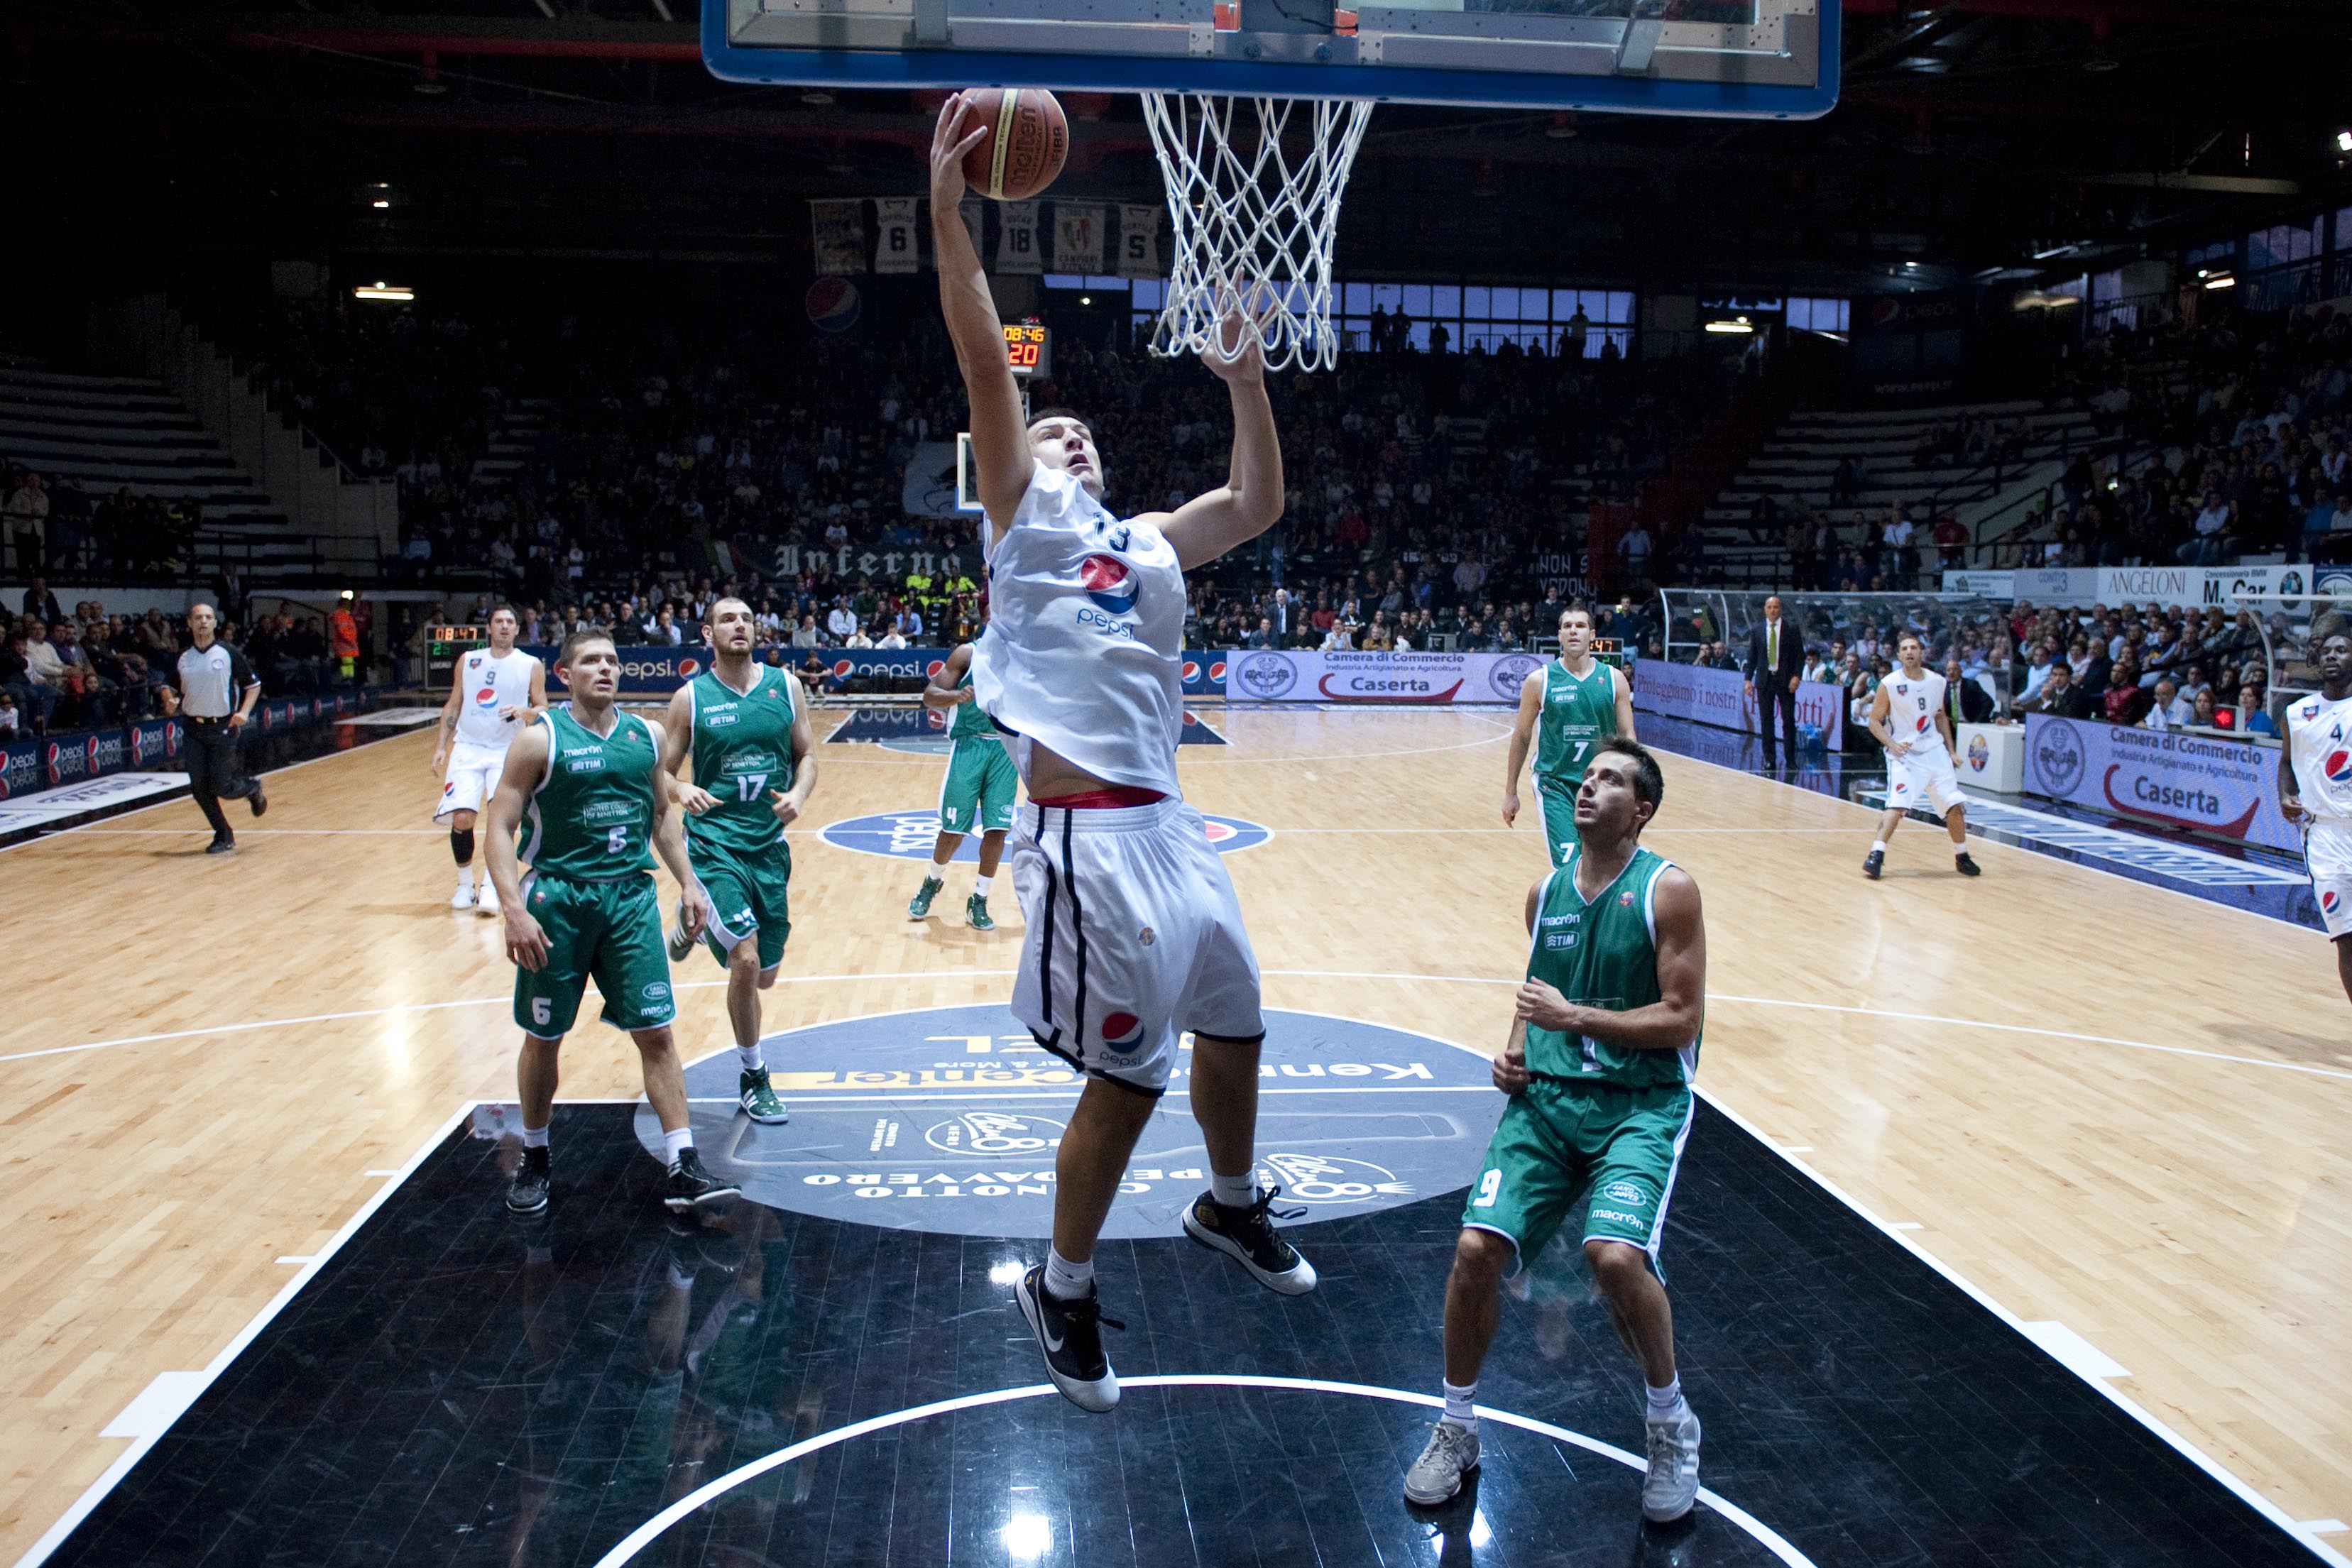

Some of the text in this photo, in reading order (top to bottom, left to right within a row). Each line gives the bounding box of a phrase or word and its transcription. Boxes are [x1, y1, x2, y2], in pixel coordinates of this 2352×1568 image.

[890, 226, 907, 252] 6
[1009, 227, 1031, 253] 18
[1128, 234, 1147, 260] 5
[1003, 327, 1044, 342] 08:46
[1009, 344, 1039, 365] 20
[775, 545, 961, 577] Inferno
[1539, 554, 1571, 574] NON
[2250, 569, 2268, 578] BMW
[2108, 571, 2186, 596] ANGELONI
[2203, 579, 2224, 604] M.
[1077, 608, 1134, 640] pepsi
[435, 627, 478, 642] 08:47
[1324, 652, 1465, 663] Camera di Commercio
[1417, 664, 1462, 673] Agricoltura
[485, 671, 496, 686] 9
[1350, 676, 1430, 692] Caserta
[1551, 684, 1578, 693] macron
[1636, 674, 1697, 703] Proteggiamo
[1705, 689, 1737, 711] nostri
[703, 702, 738, 714] macron
[1918, 697, 1927, 711] 8
[721, 714, 736, 723] TIM
[143, 727, 164, 745] pepsi
[2330, 723, 2344, 742] 4
[62, 742, 85, 760] pepsi
[100, 736, 122, 753] pepsi
[563, 745, 603, 758] macron
[1572, 741, 1590, 762] 7
[2110, 727, 2263, 766] Camera di Commercio
[11, 750, 36, 770] pepsi
[584, 760, 601, 770] TIM
[2111, 747, 2148, 763] Industria
[2148, 753, 2197, 772] Artigianato
[2205, 764, 2258, 783] Agricoltura
[737, 774, 768, 803] 17
[2134, 775, 2220, 816] Caserta
[2330, 781, 2352, 795] pep
[946, 806, 958, 826] 4
[1560, 842, 1576, 864] 7
[1541, 913, 1580, 927] macron
[1556, 933, 1575, 947] TIM
[532, 997, 552, 1026] 6
[1100, 1051, 1142, 1068] pepsi
[816, 1069, 1077, 1086] Center
[803, 1168, 1203, 1185] PE DAVVERO
[854, 1183, 1151, 1199] CNOTTO
[1472, 1168, 1503, 1207] 9
[1612, 1184, 1634, 1195] LAND
[1612, 1190, 1639, 1202] ROVER
[1592, 1208, 1644, 1231] macron
